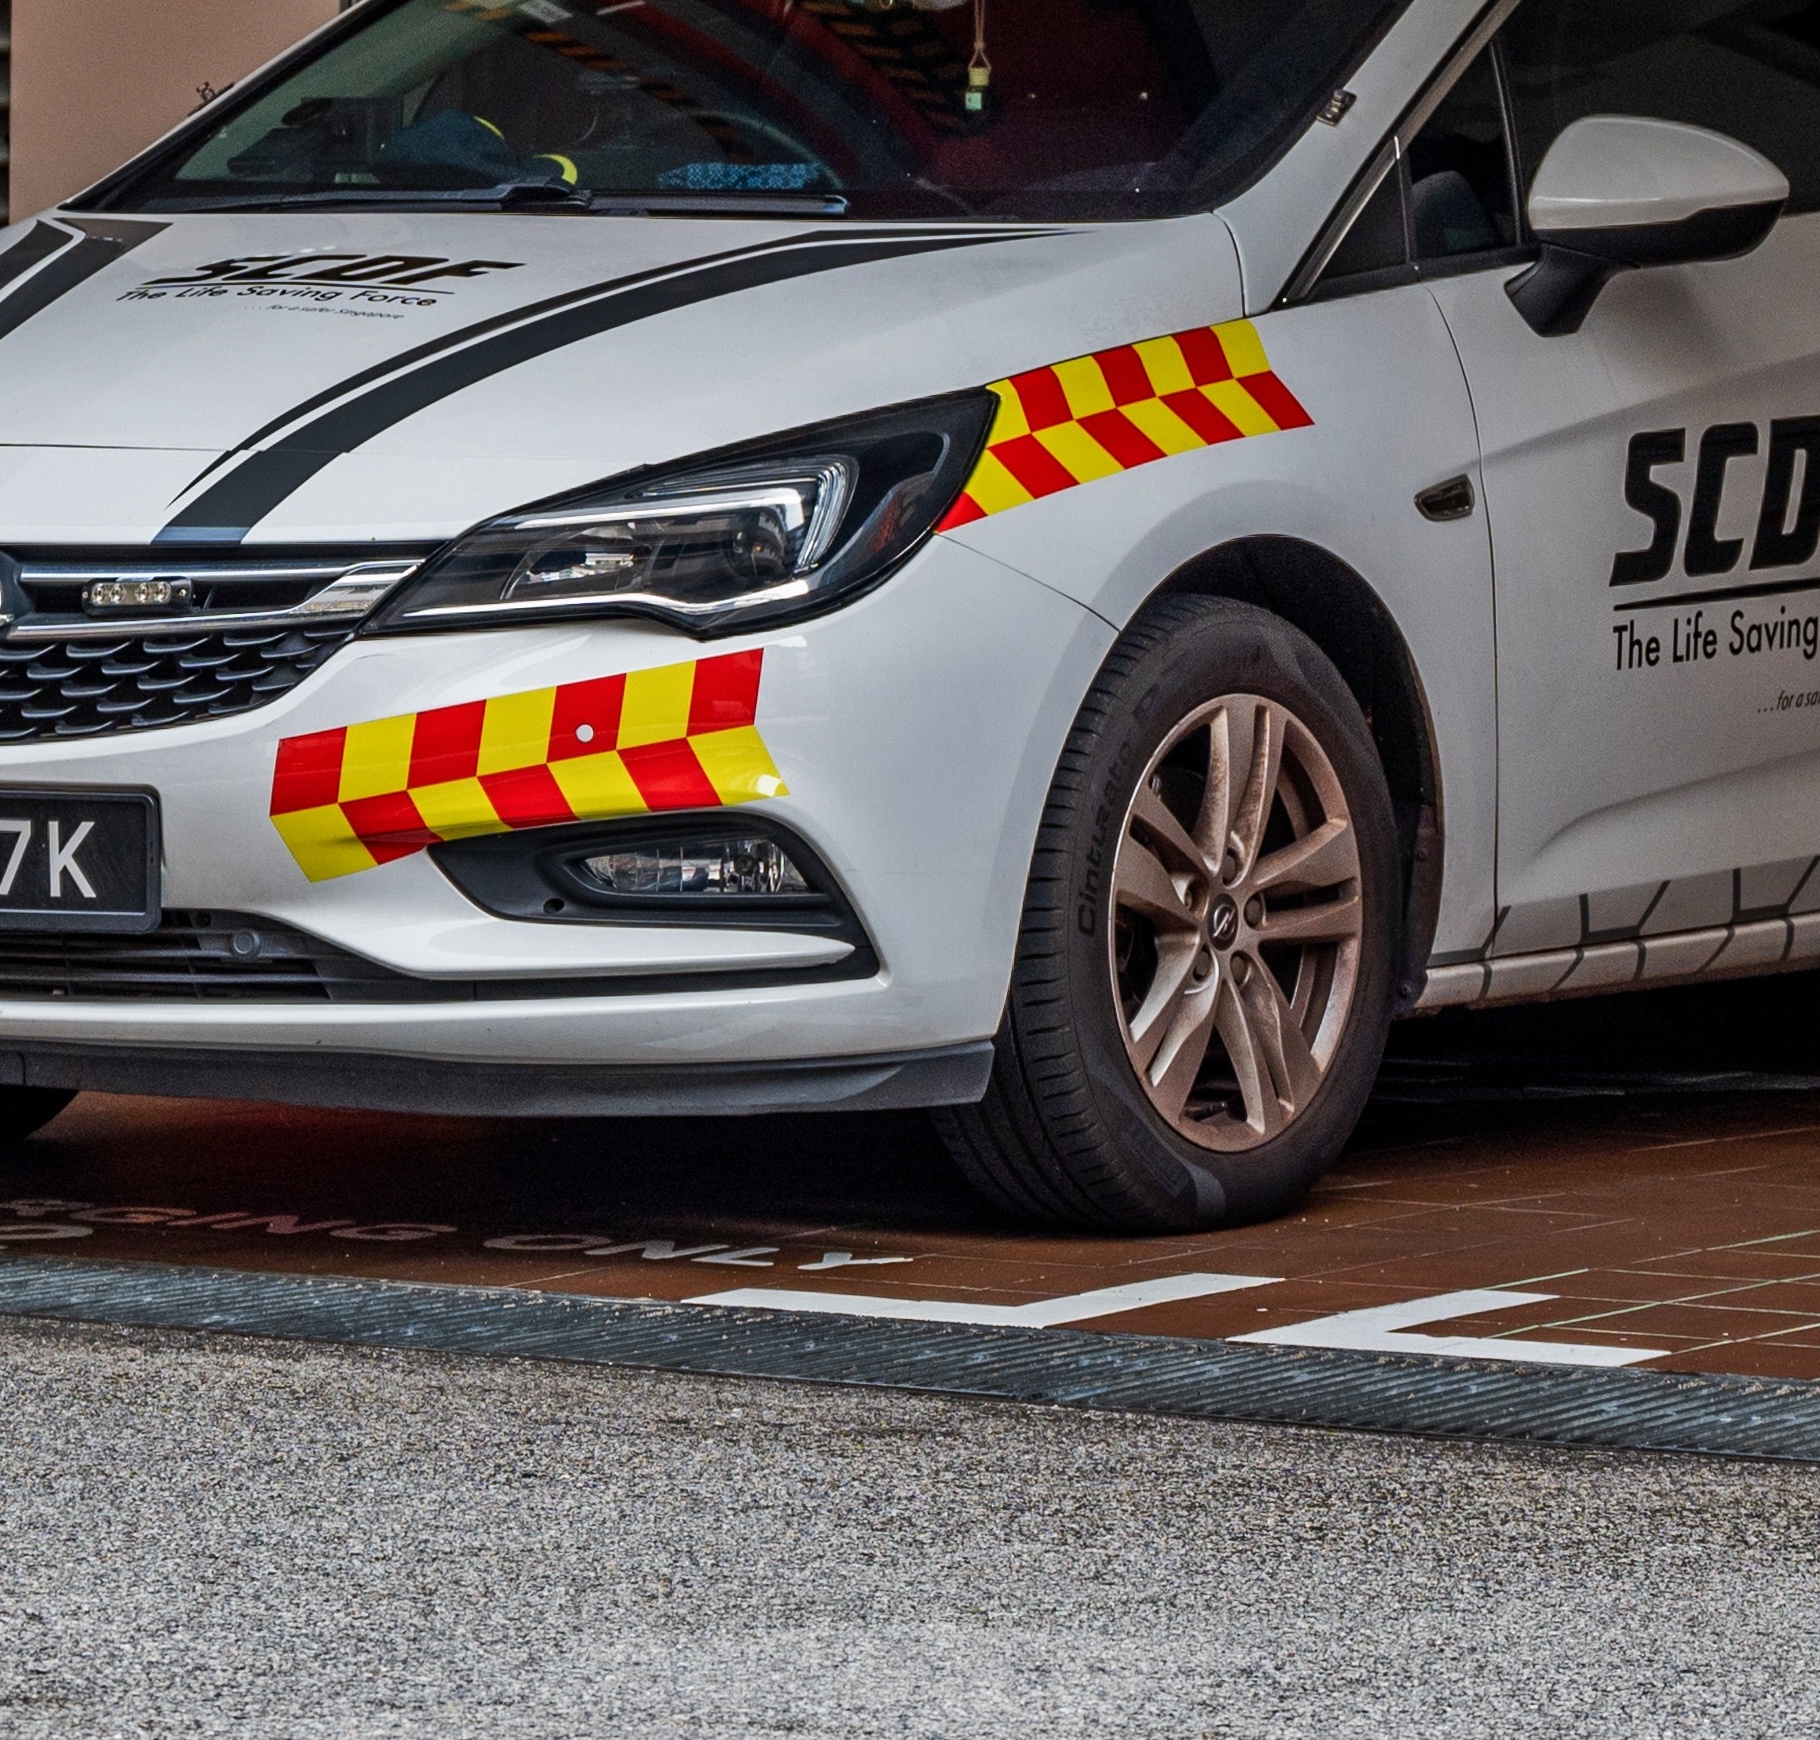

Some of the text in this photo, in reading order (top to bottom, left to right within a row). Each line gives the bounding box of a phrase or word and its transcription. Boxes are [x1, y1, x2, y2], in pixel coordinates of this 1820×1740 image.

[140, 254, 527, 286] SCDF
[115, 285, 438, 307] The Life Saving Force
[1613, 619, 1661, 671] The
[1672, 611, 1717, 663] Life
[1729, 606, 1818, 660] Saving
[1795, 693, 1805, 708] a
[482, 1234, 914, 1271] ONLY
